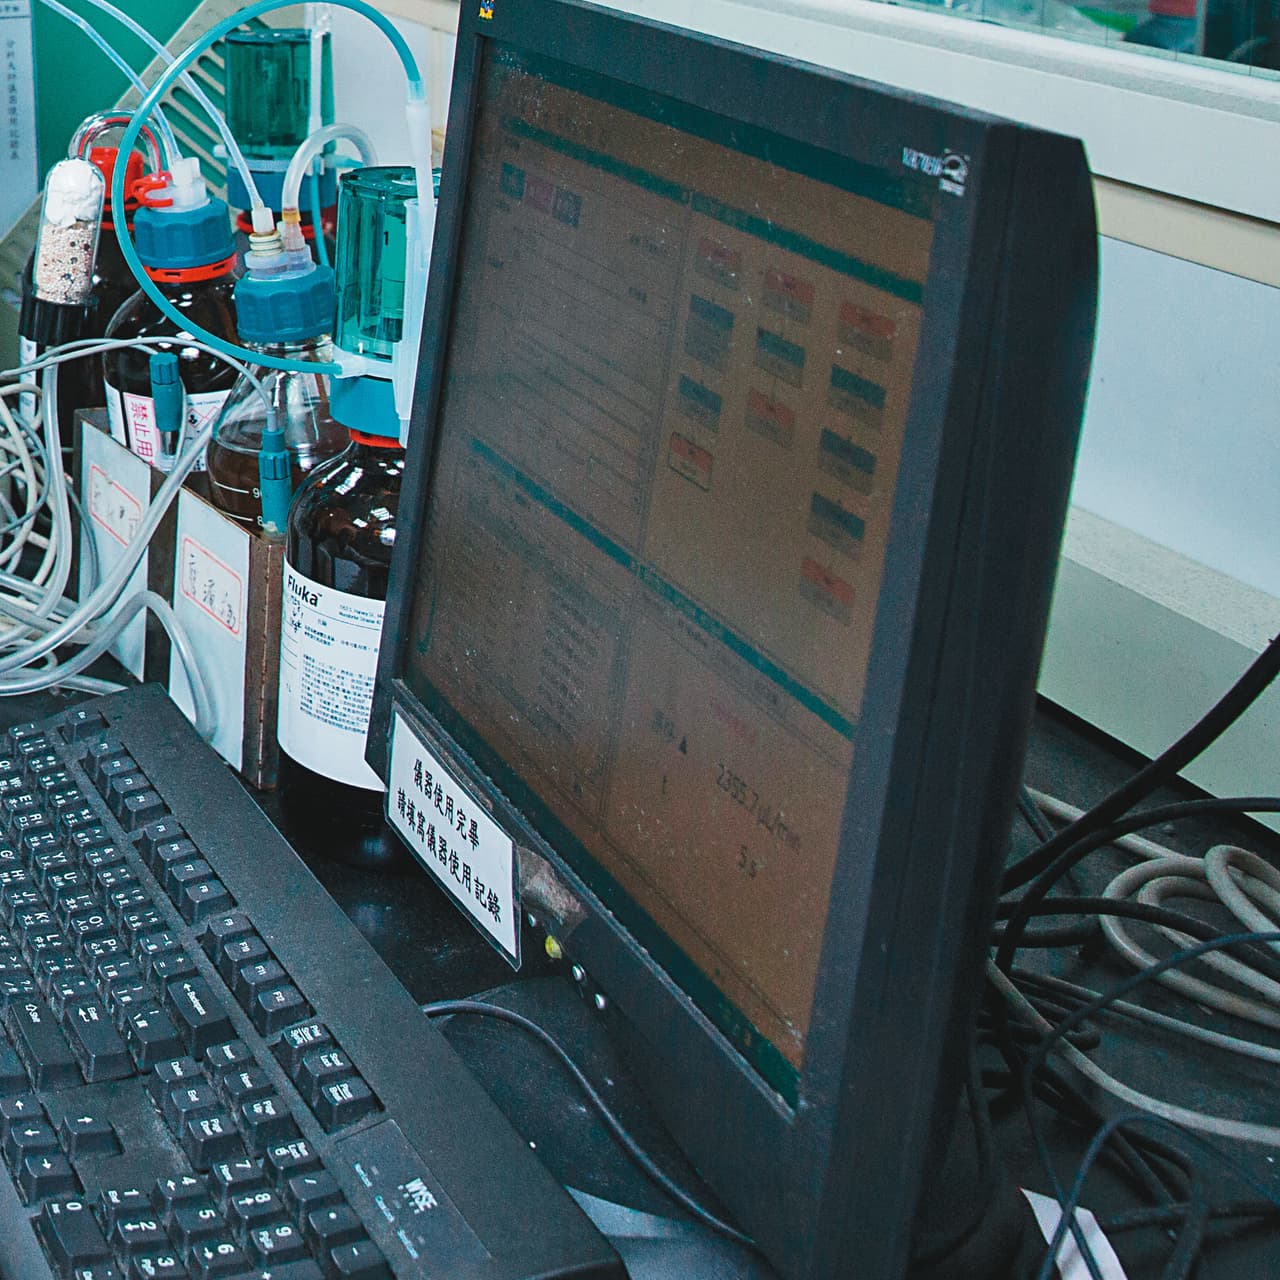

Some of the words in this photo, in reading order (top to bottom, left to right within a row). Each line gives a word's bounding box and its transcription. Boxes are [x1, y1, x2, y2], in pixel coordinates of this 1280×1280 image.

[130, 402, 154, 466] 禁止用
[413, 758, 480, 851] 儀器使用完畢
[397, 787, 501, 923] 請填寫儀器使用記錄
[235, 1160, 252, 1168] 7
[182, 1176, 197, 1185] 4
[255, 1193, 271, 1203] 8
[66, 1202, 82, 1210] 0
[199, 1209, 216, 1219] 5
[140, 1221, 156, 1230] 2
[275, 1226, 292, 1236] 9
[218, 1244, 235, 1254] 6
[158, 1257, 175, 1267] 3
